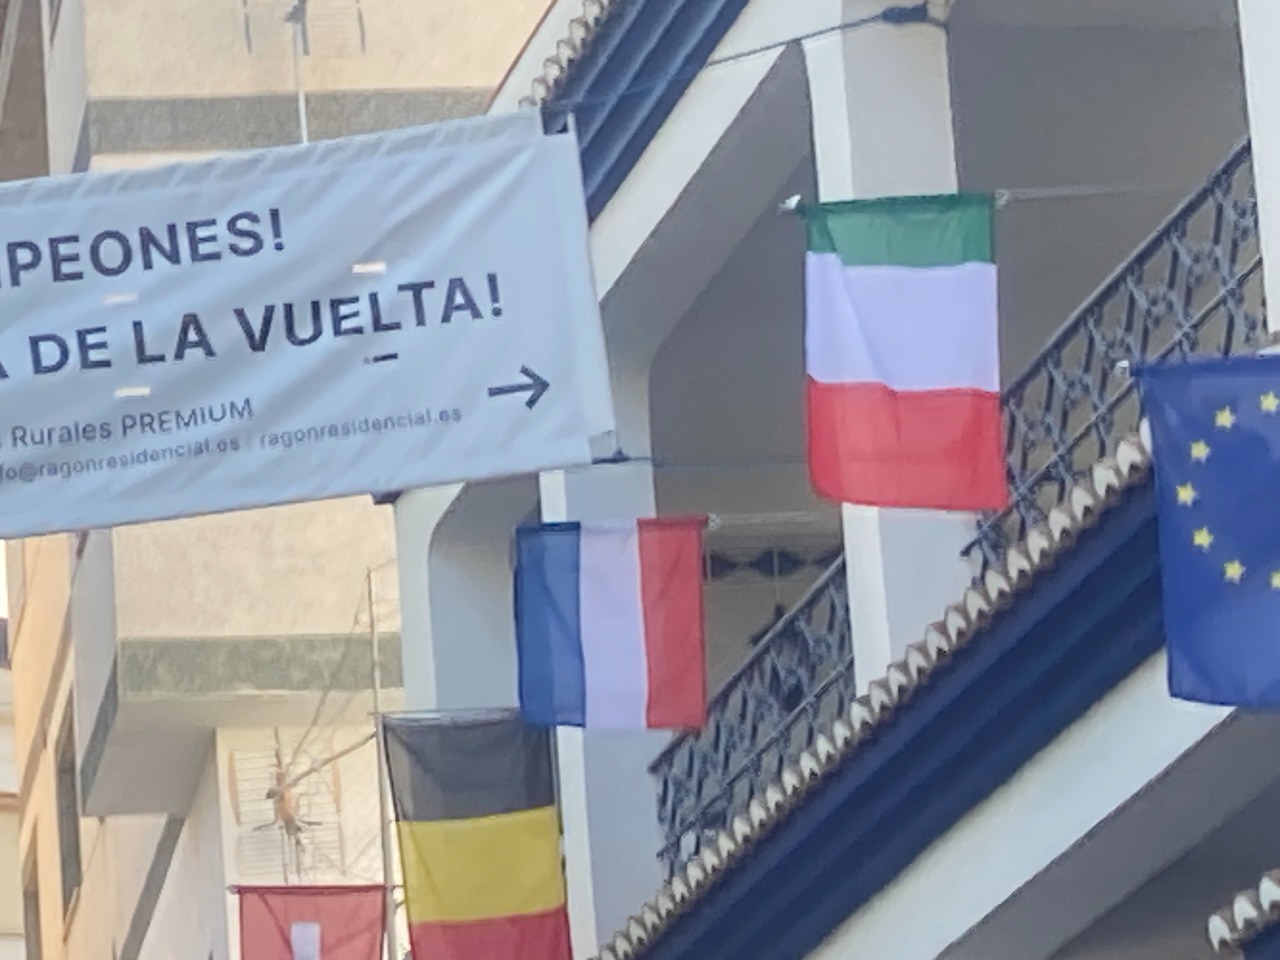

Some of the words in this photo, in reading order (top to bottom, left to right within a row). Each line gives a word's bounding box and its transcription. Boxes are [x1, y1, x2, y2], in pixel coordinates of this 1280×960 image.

[28, 326, 112, 376] DE
[132, 313, 217, 366] LA
[233, 273, 503, 353] VUELTA!
[11, 420, 113, 448] Rurales
[121, 397, 254, 438] PREMIUM
